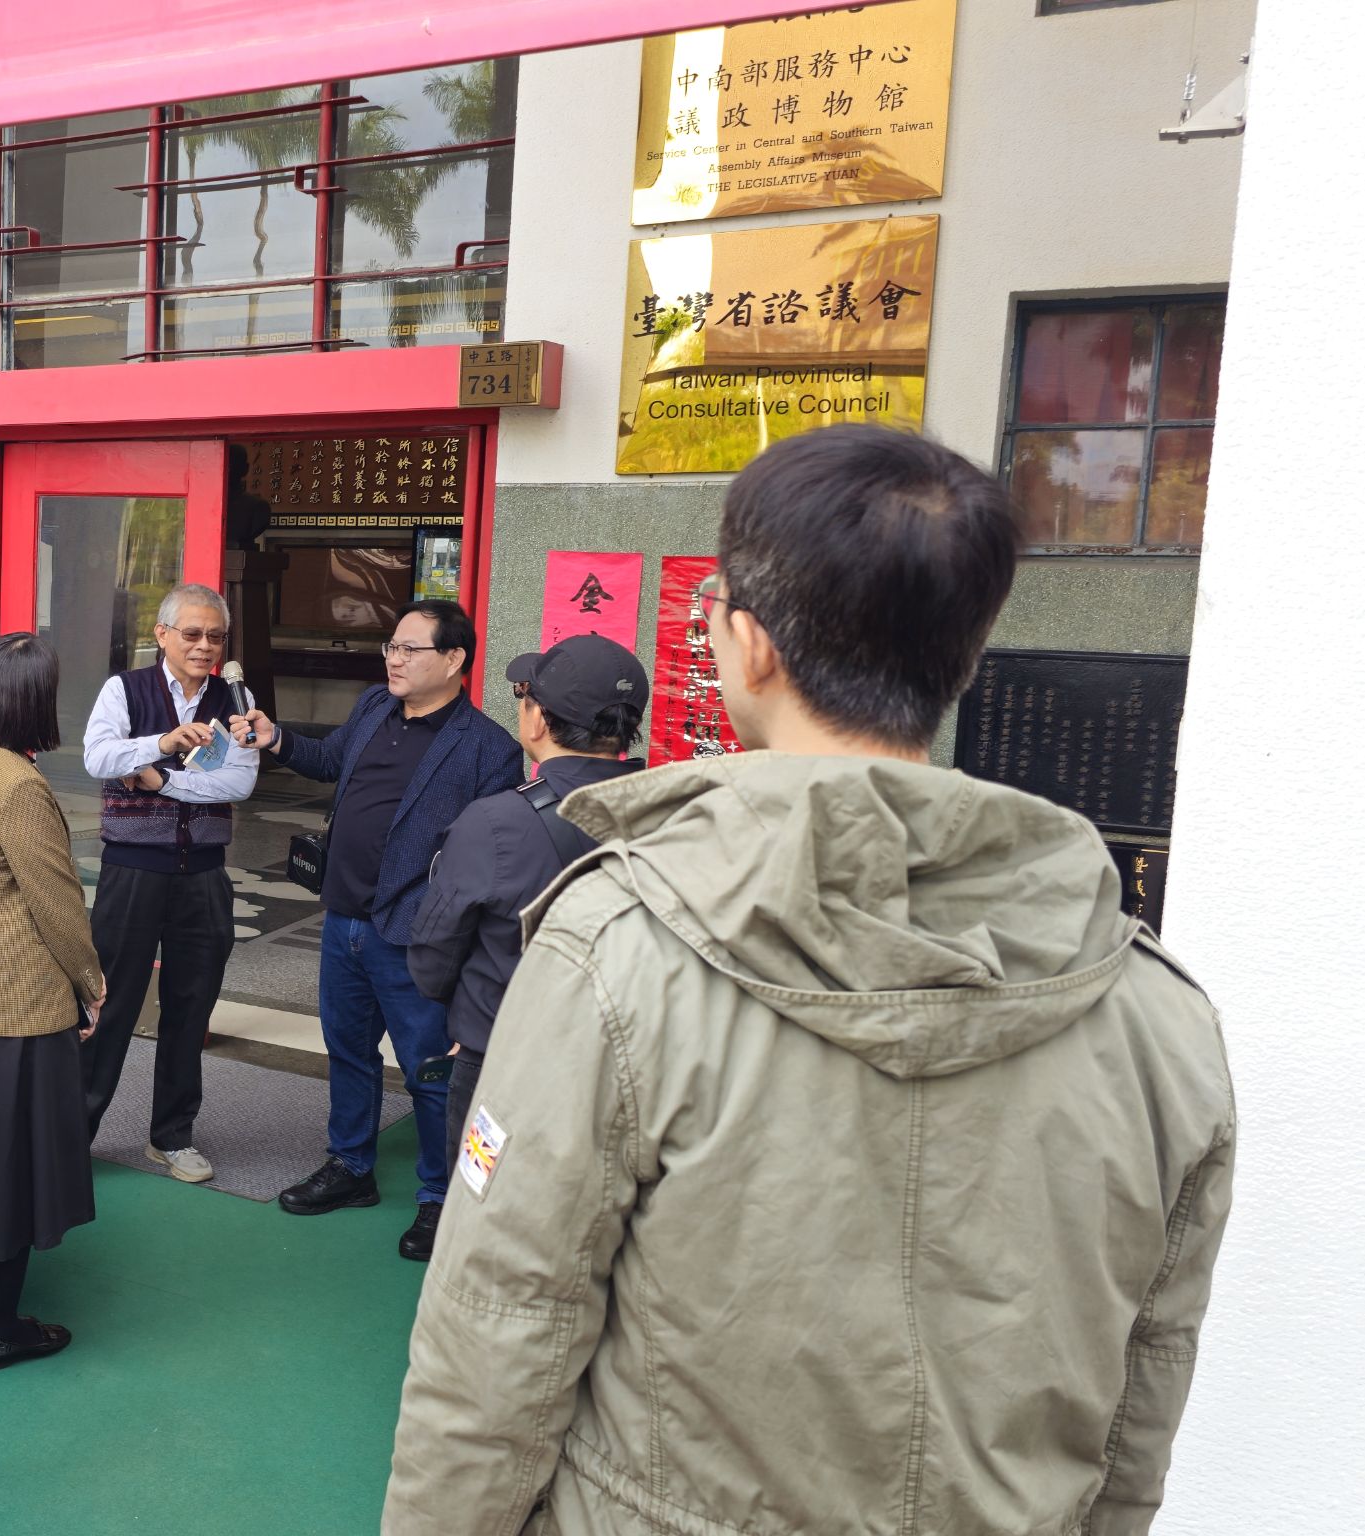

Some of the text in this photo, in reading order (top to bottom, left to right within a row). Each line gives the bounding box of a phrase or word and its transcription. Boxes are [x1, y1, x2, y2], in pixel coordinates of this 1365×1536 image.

[676, 44, 911, 97] 中南部服務中心
[674, 83, 909, 136] 議政博物館
[646, 120, 934, 162] Service Center in Central and Southern Taiwan
[708, 149, 862, 174] Assembly Affairs Museum
[707, 168, 861, 194] THE LEGISLATIVE YUAN
[632, 279, 922, 338] 臺灣省諮議會
[468, 349, 513, 364] 中正路
[468, 374, 512, 395] 734
[668, 361, 874, 391] Taiwan Provincial
[648, 390, 890, 421] Consultative Council
